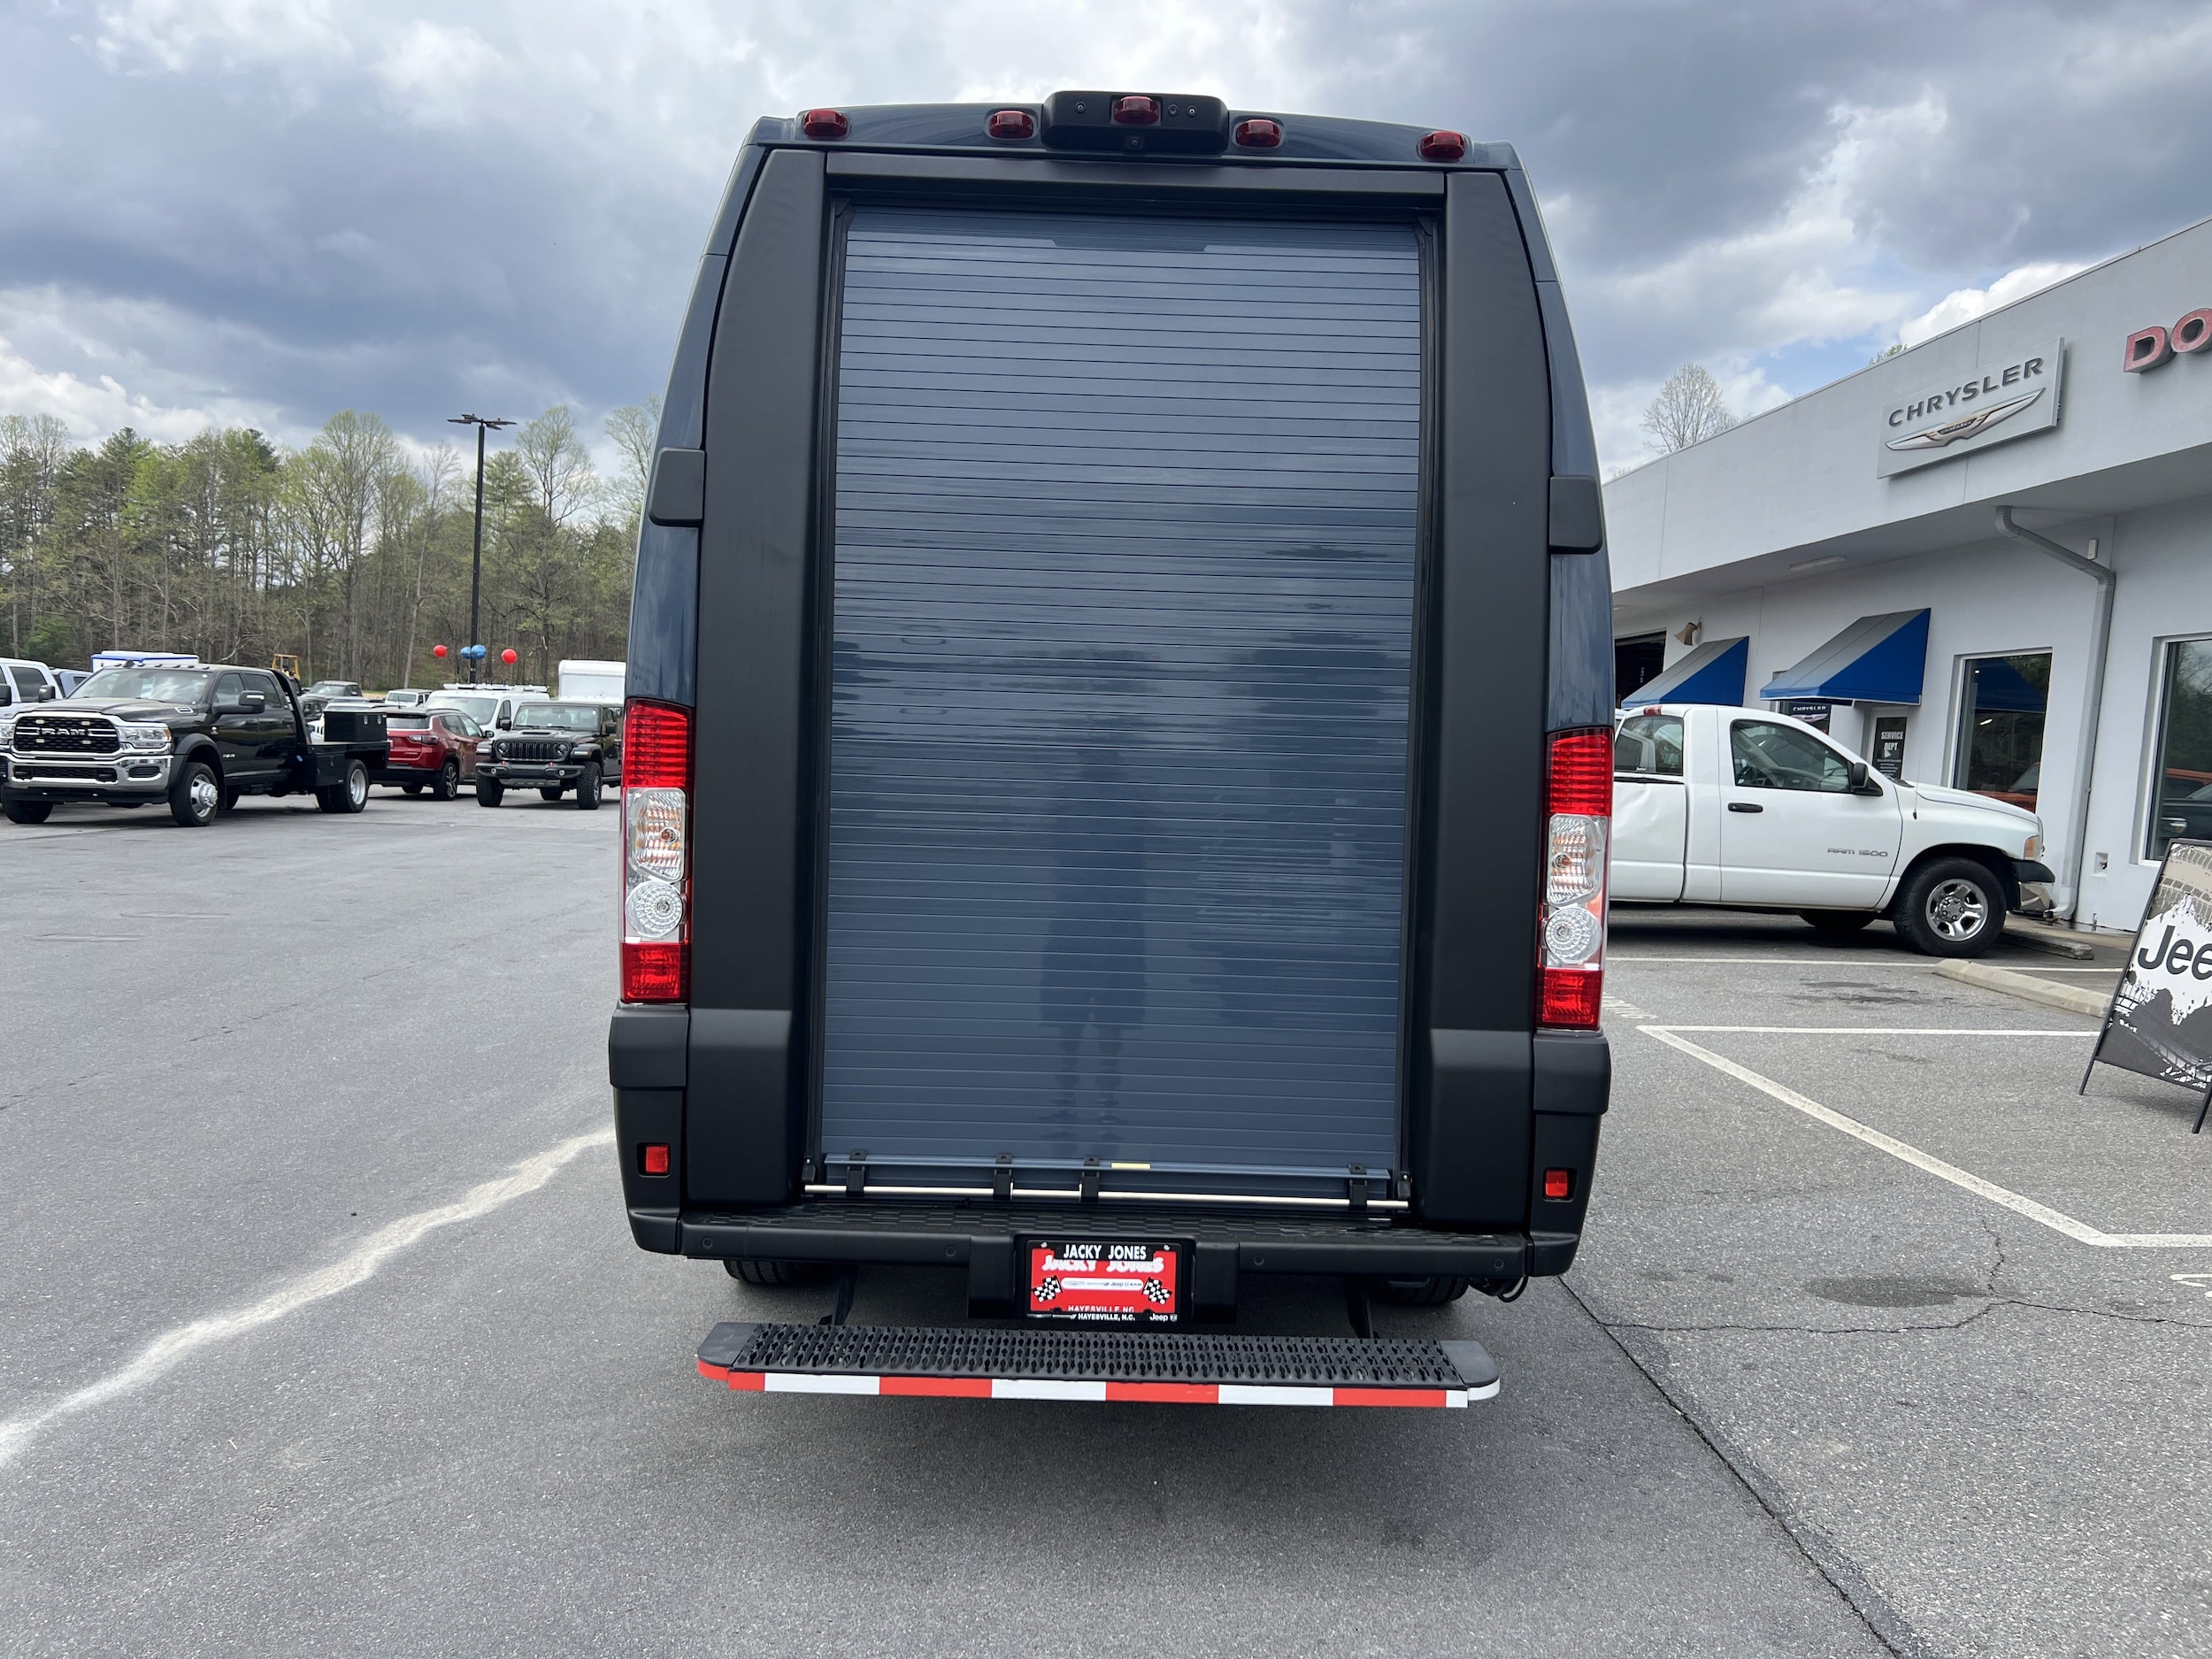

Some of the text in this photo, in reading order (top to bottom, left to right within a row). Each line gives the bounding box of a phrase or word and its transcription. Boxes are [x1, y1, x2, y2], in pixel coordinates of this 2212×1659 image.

[2124, 307, 2212, 373] DO
[1888, 357, 2045, 427] CHRYSLER
[41, 727, 86, 736] RAM
[1880, 731, 1904, 741] SERVICE
[1884, 742, 1899, 751] DEPT
[2138, 925, 2212, 980] Jee
[1063, 1244, 1147, 1260] JACKY JONES
